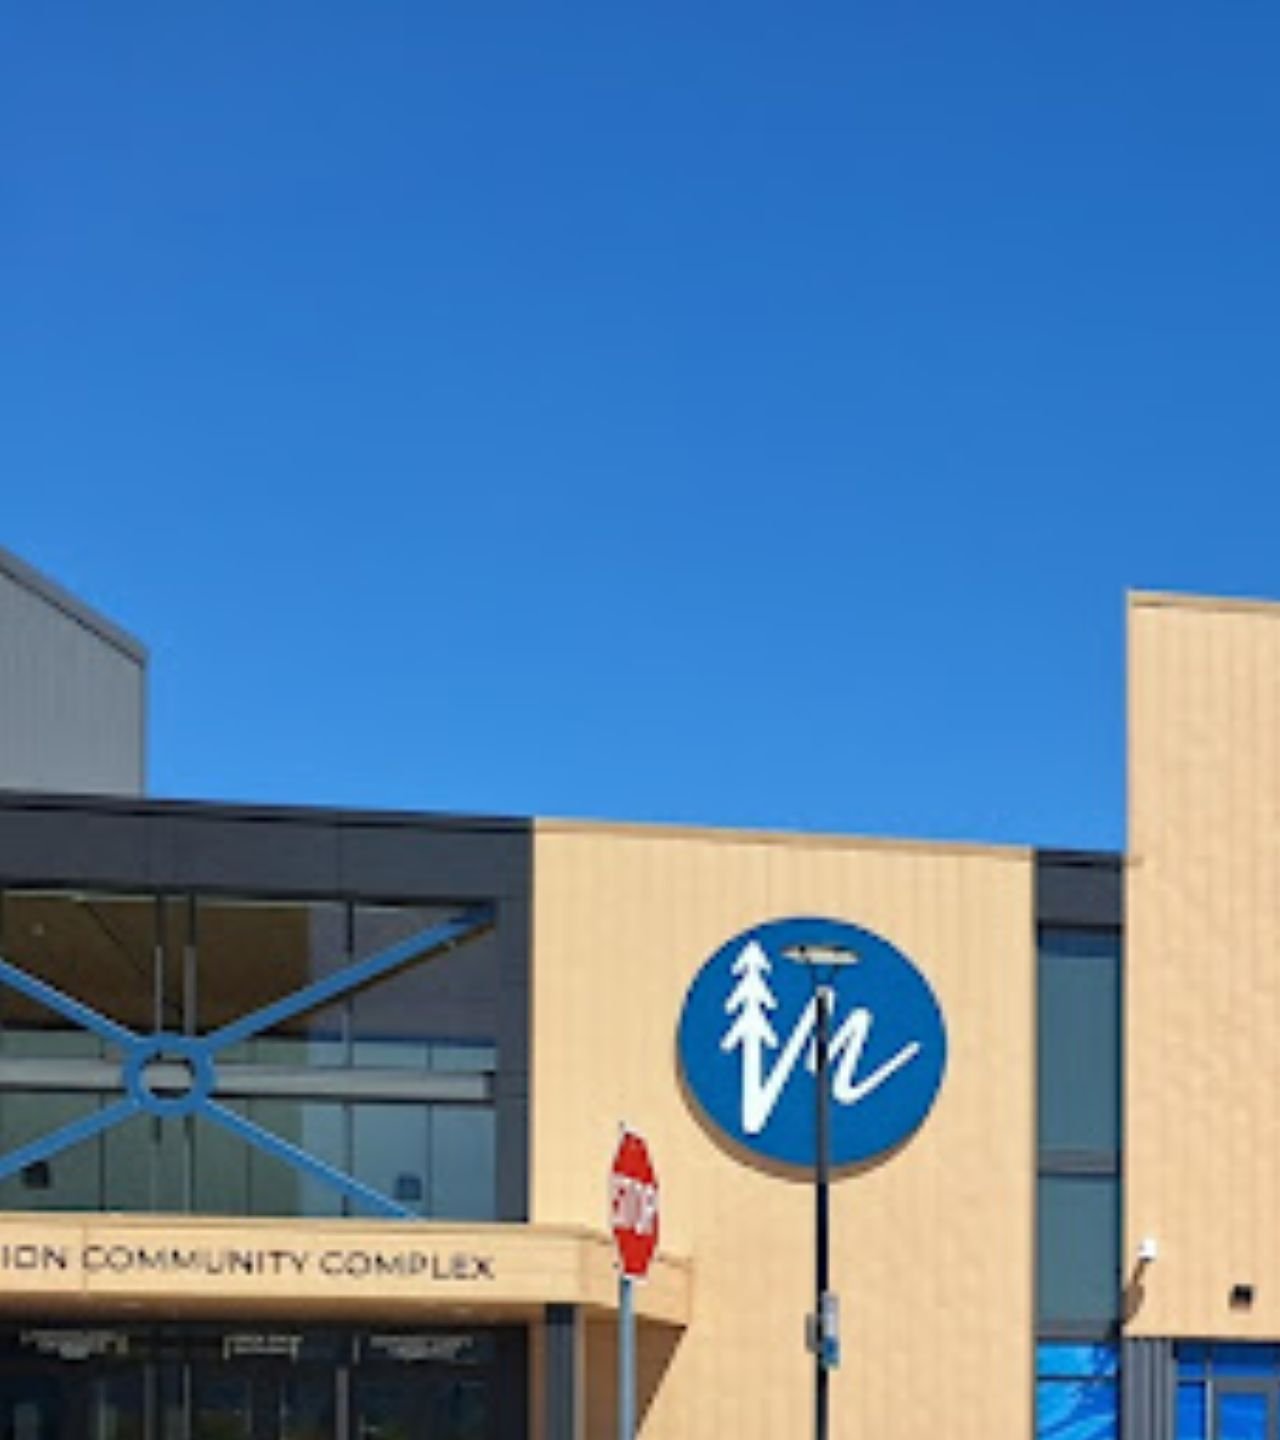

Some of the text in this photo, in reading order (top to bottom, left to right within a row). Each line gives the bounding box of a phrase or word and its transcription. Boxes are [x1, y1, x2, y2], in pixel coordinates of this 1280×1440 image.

[609, 1174, 658, 1234] STOP
[3, 1245, 494, 1281] ION COMMUNITY COMPLEX
